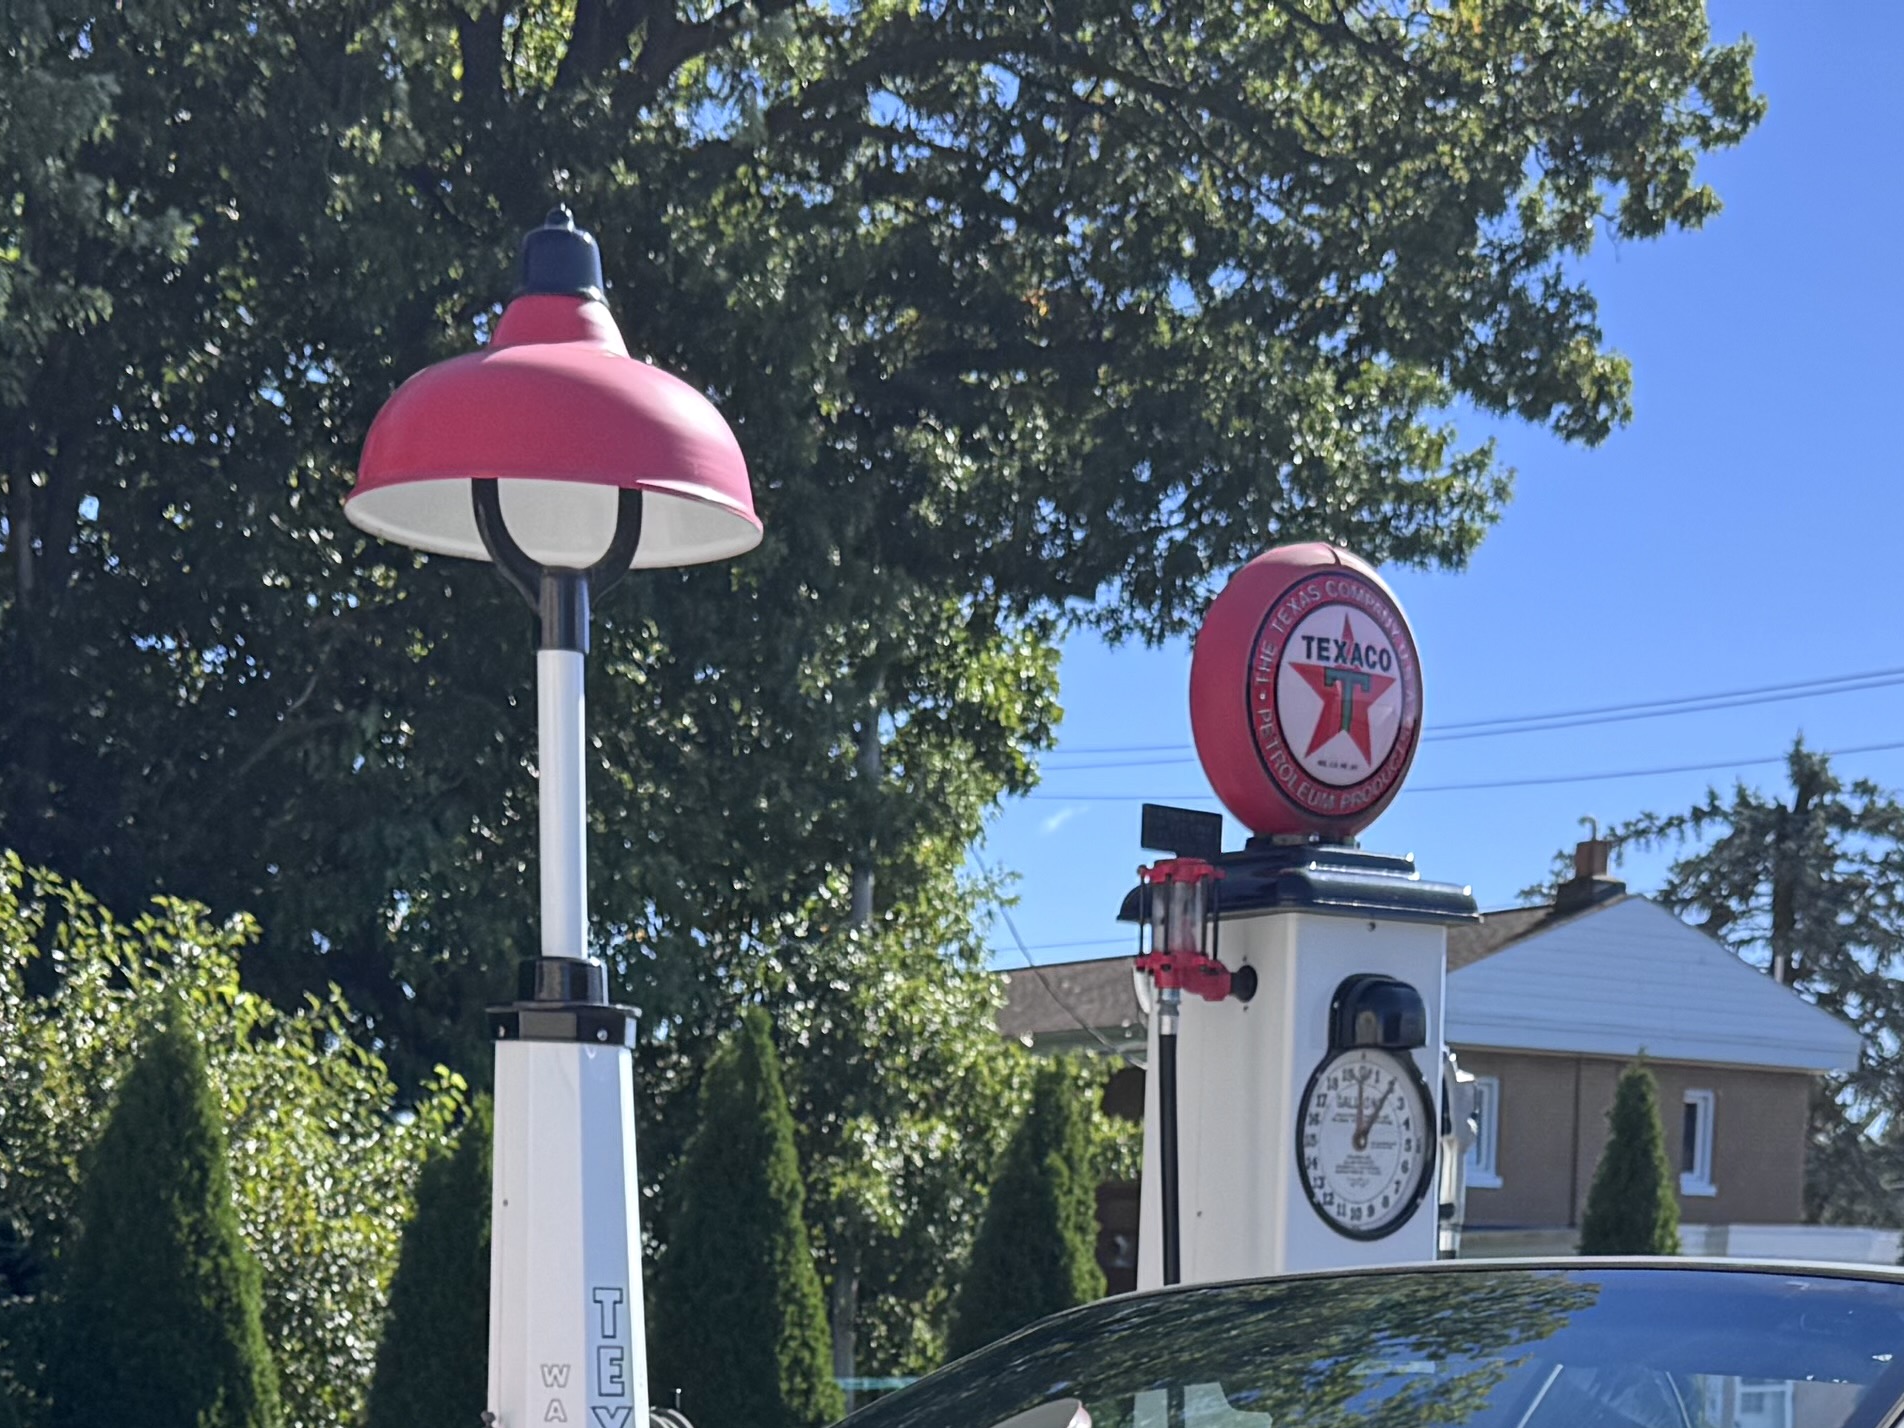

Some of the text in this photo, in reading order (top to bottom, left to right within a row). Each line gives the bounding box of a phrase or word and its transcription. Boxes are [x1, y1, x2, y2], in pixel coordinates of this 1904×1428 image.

[1271, 585, 1321, 634] TEXAS
[1302, 636, 1392, 672] TEXACO
[1257, 709, 1336, 809] PETROLEUM
